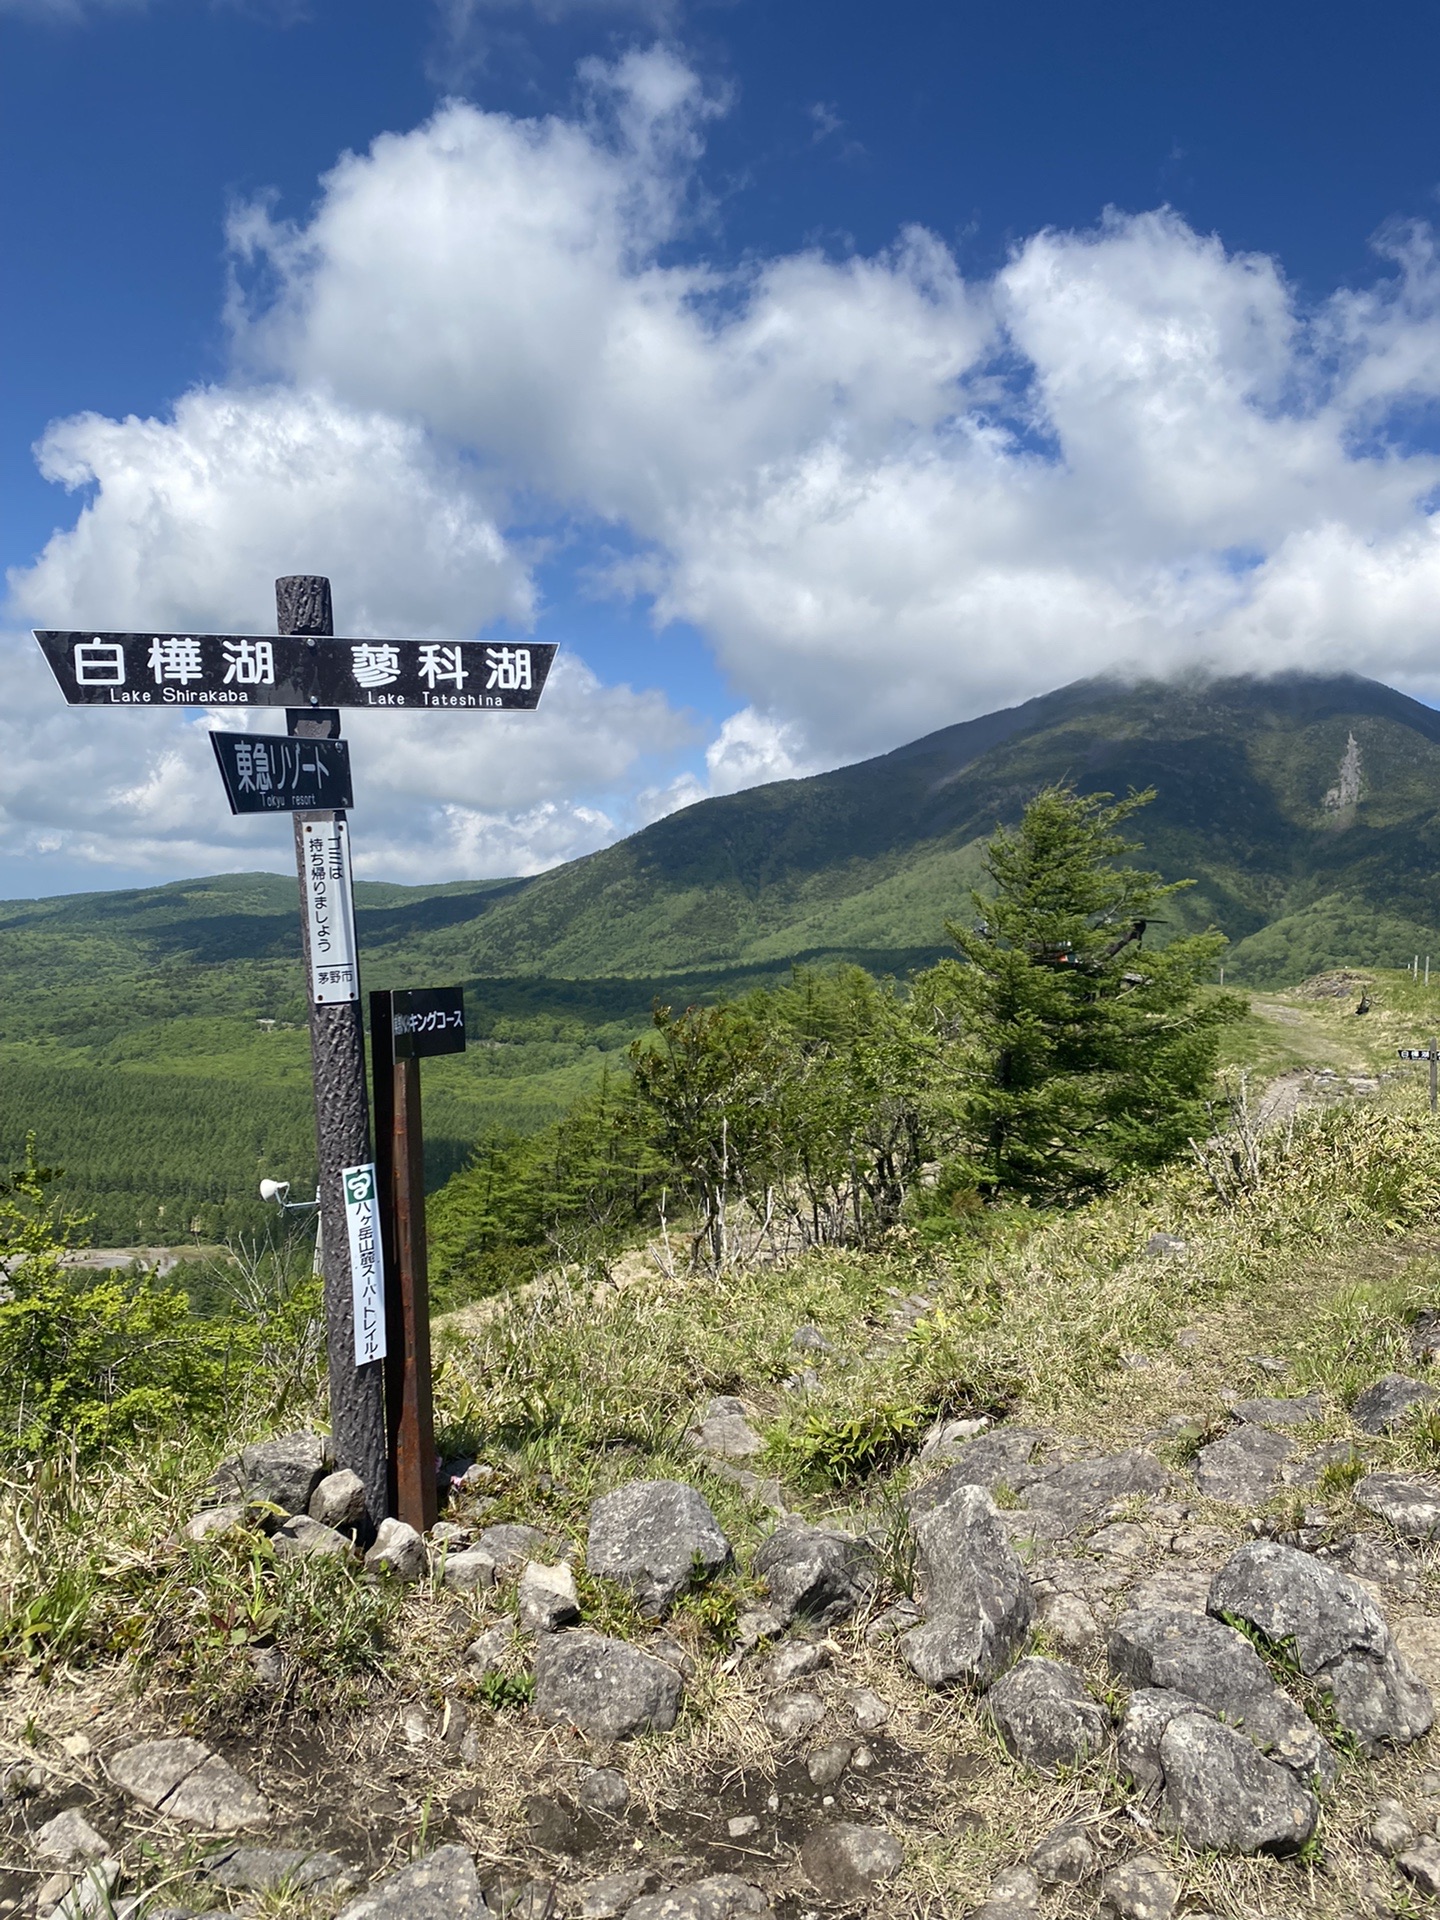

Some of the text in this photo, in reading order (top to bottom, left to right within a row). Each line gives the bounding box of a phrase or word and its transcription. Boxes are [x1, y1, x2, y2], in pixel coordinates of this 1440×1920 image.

[74, 637, 275, 685] 白樺湖
[351, 643, 532, 690] 蓼科湖
[110, 687, 249, 703] Lake Shirakaba
[368, 691, 503, 706] Lake Tateshina
[234, 740, 330, 794] 東急リゾート
[260, 791, 316, 808] Tokyu resort
[309, 838, 332, 953] 持ち帰りましょう
[318, 970, 353, 985] 茅野市
